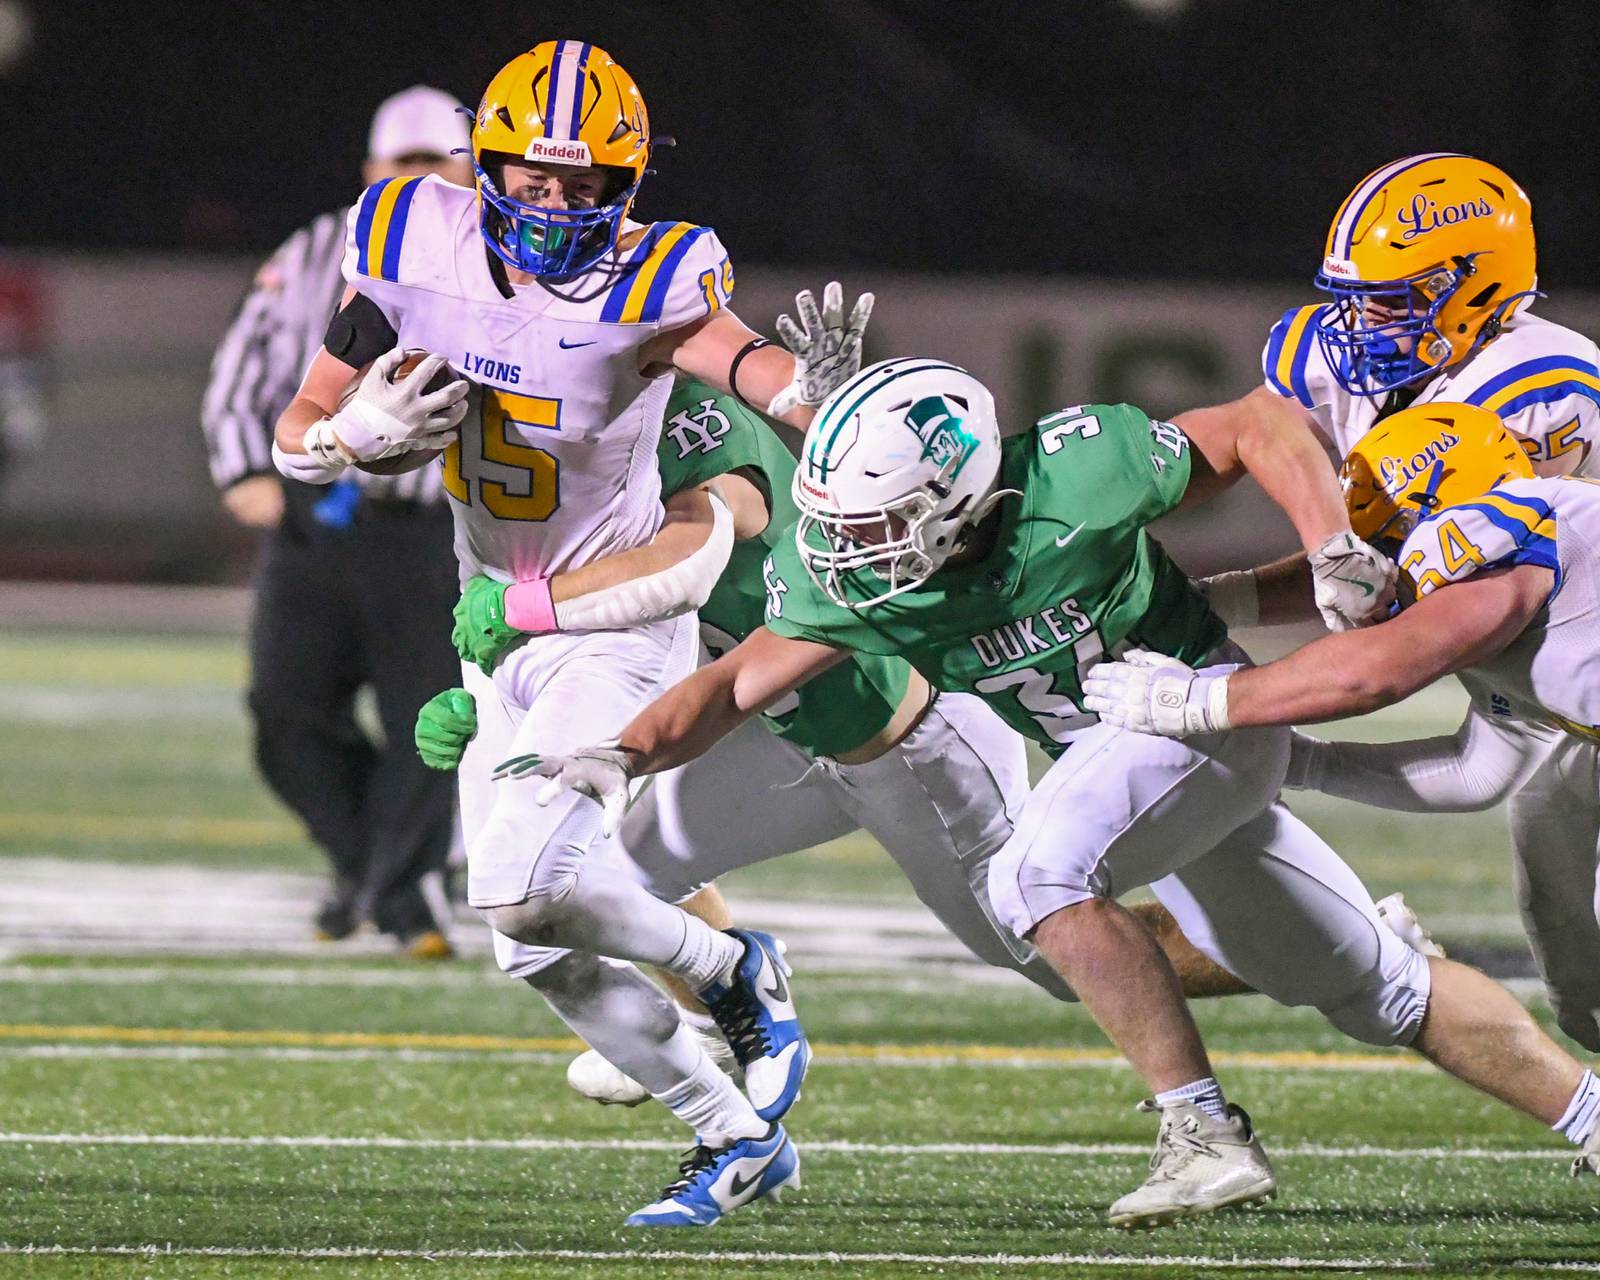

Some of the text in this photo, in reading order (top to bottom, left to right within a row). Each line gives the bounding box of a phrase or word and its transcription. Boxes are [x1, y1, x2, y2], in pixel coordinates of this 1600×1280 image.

[532, 143, 585, 160] Riddell
[1397, 192, 1494, 240] Lions
[463, 352, 522, 384] LYONS
[1373, 431, 1460, 504] Lions
[1401, 518, 1487, 601] 64
[969, 598, 1093, 669] DUKES
